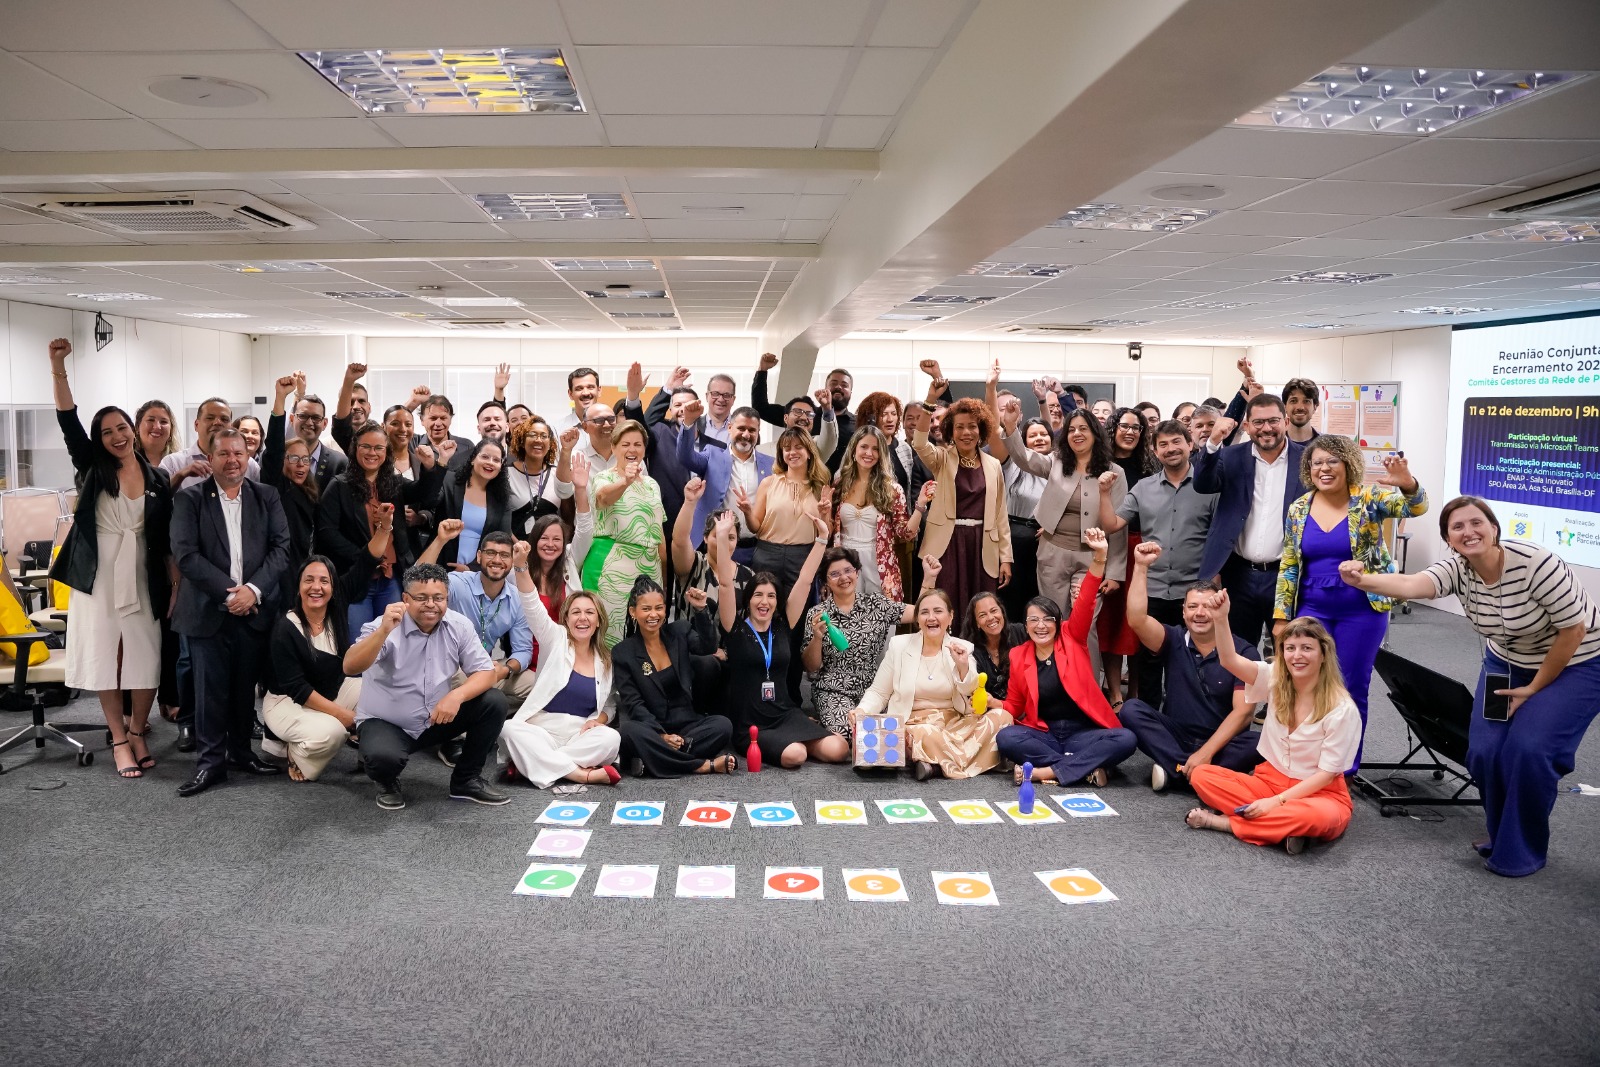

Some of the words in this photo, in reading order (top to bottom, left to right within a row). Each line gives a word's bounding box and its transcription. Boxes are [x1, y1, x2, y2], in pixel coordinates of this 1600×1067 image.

[1499, 349, 1544, 361] Reunião
[1492, 363, 1573, 375] Encerramento
[1468, 378, 1499, 387] Comitês
[1501, 377, 1536, 386] Gestores
[1538, 376, 1549, 385] da
[1552, 375, 1576, 384] Rede
[1578, 374, 1590, 383] de
[1469, 406, 1477, 416] 11
[1479, 408, 1485, 416] e
[1487, 406, 1497, 416] 12
[1499, 406, 1512, 416] de
[1514, 406, 1573, 417] dezembro
[1582, 405, 1599, 417] 9h
[1508, 433, 1550, 443] Participação
[1551, 434, 1578, 443] virtual:
[1490, 441, 1528, 449] Transmissão
[1529, 442, 1539, 450] via
[1540, 442, 1572, 451] Microsoft
[1574, 444, 1599, 453] Teams
[1499, 457, 1540, 468] Participação
[1541, 460, 1581, 470] presencial:
[1476, 463, 1495, 471] Escola
[1495, 465, 1523, 474] Nacional
[1524, 466, 1532, 475] de
[1533, 468, 1584, 480] Administração
[1506, 473, 1525, 482] ENAP
[1530, 475, 1544, 484] Sala
[1545, 477, 1574, 487] Inovatio
[1488, 480, 1501, 488] SPO
[1502, 481, 1517, 490] Área
[1529, 484, 1541, 492] Asa
[1542, 486, 1554, 494] Sul,
[1555, 487, 1596, 497] Brasília-DF
[1577, 531, 1594, 540] Rede
[1066, 801, 1101, 810] Fim
[559, 809, 575, 817] 9
[625, 809, 652, 817] 10
[699, 811, 718, 820] 11
[760, 810, 786, 819] 12
[828, 808, 854, 817] 13
[891, 807, 921, 816] 14
[958, 808, 987, 817] 15
[551, 839, 569, 848] 8
[539, 874, 558, 885] 7
[618, 876, 636, 886] 6
[697, 876, 714, 887] 5
[785, 877, 805, 888] 4
[865, 879, 884, 890] 3
[954, 882, 974, 894] 2
[1067, 881, 1085, 892] 1
